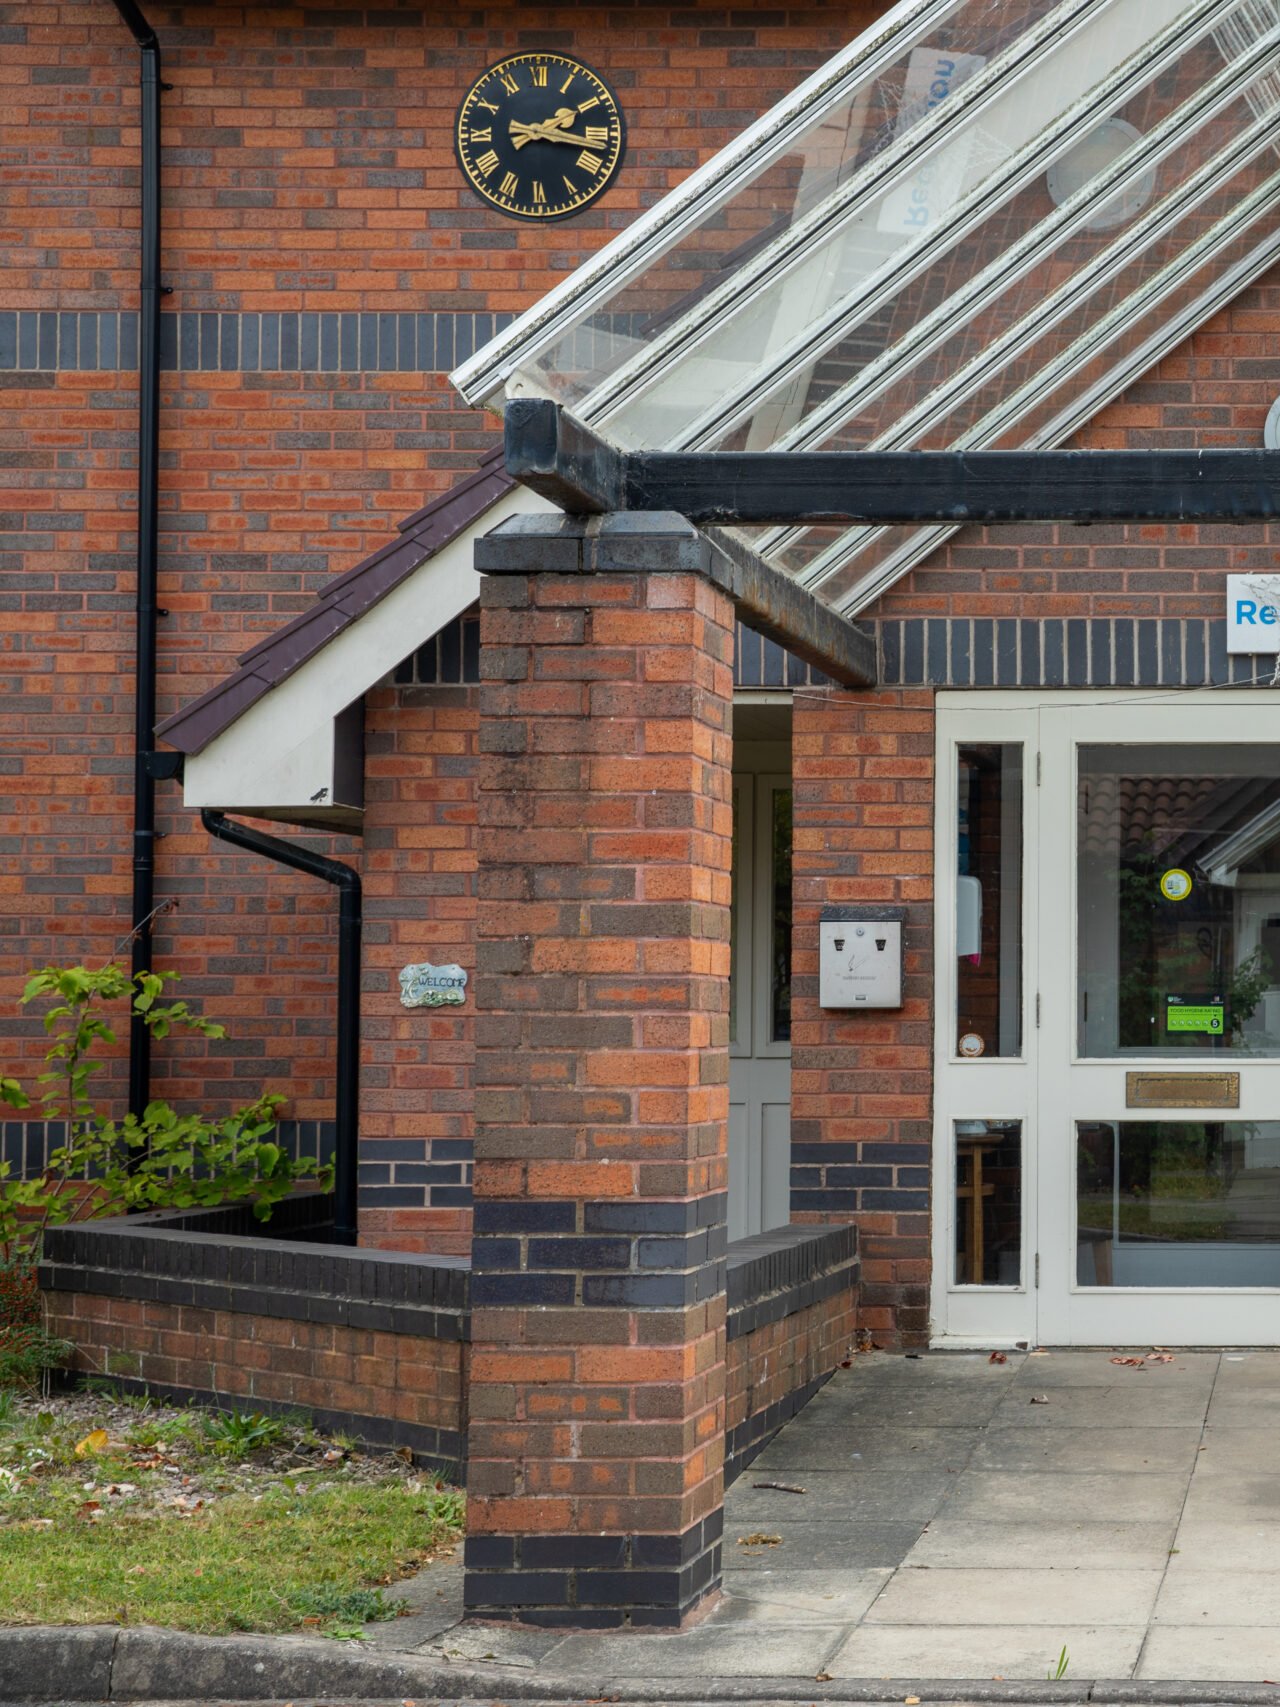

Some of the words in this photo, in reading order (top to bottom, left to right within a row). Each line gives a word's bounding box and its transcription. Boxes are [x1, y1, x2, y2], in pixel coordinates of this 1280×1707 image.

[500, 73, 520, 96] XI
[529, 66, 548, 87] XII
[560, 74, 575, 94] I
[478, 97, 500, 115] X
[578, 96, 600, 113] II
[470, 126, 492, 142] IX
[585, 126, 608, 141] III
[475, 149, 500, 178] VIII
[576, 150, 603, 175] IIII
[499, 171, 520, 198] VII
[532, 181, 547, 203] VI
[563, 175, 578, 195] V
[418, 977, 465, 987] WELCOME
